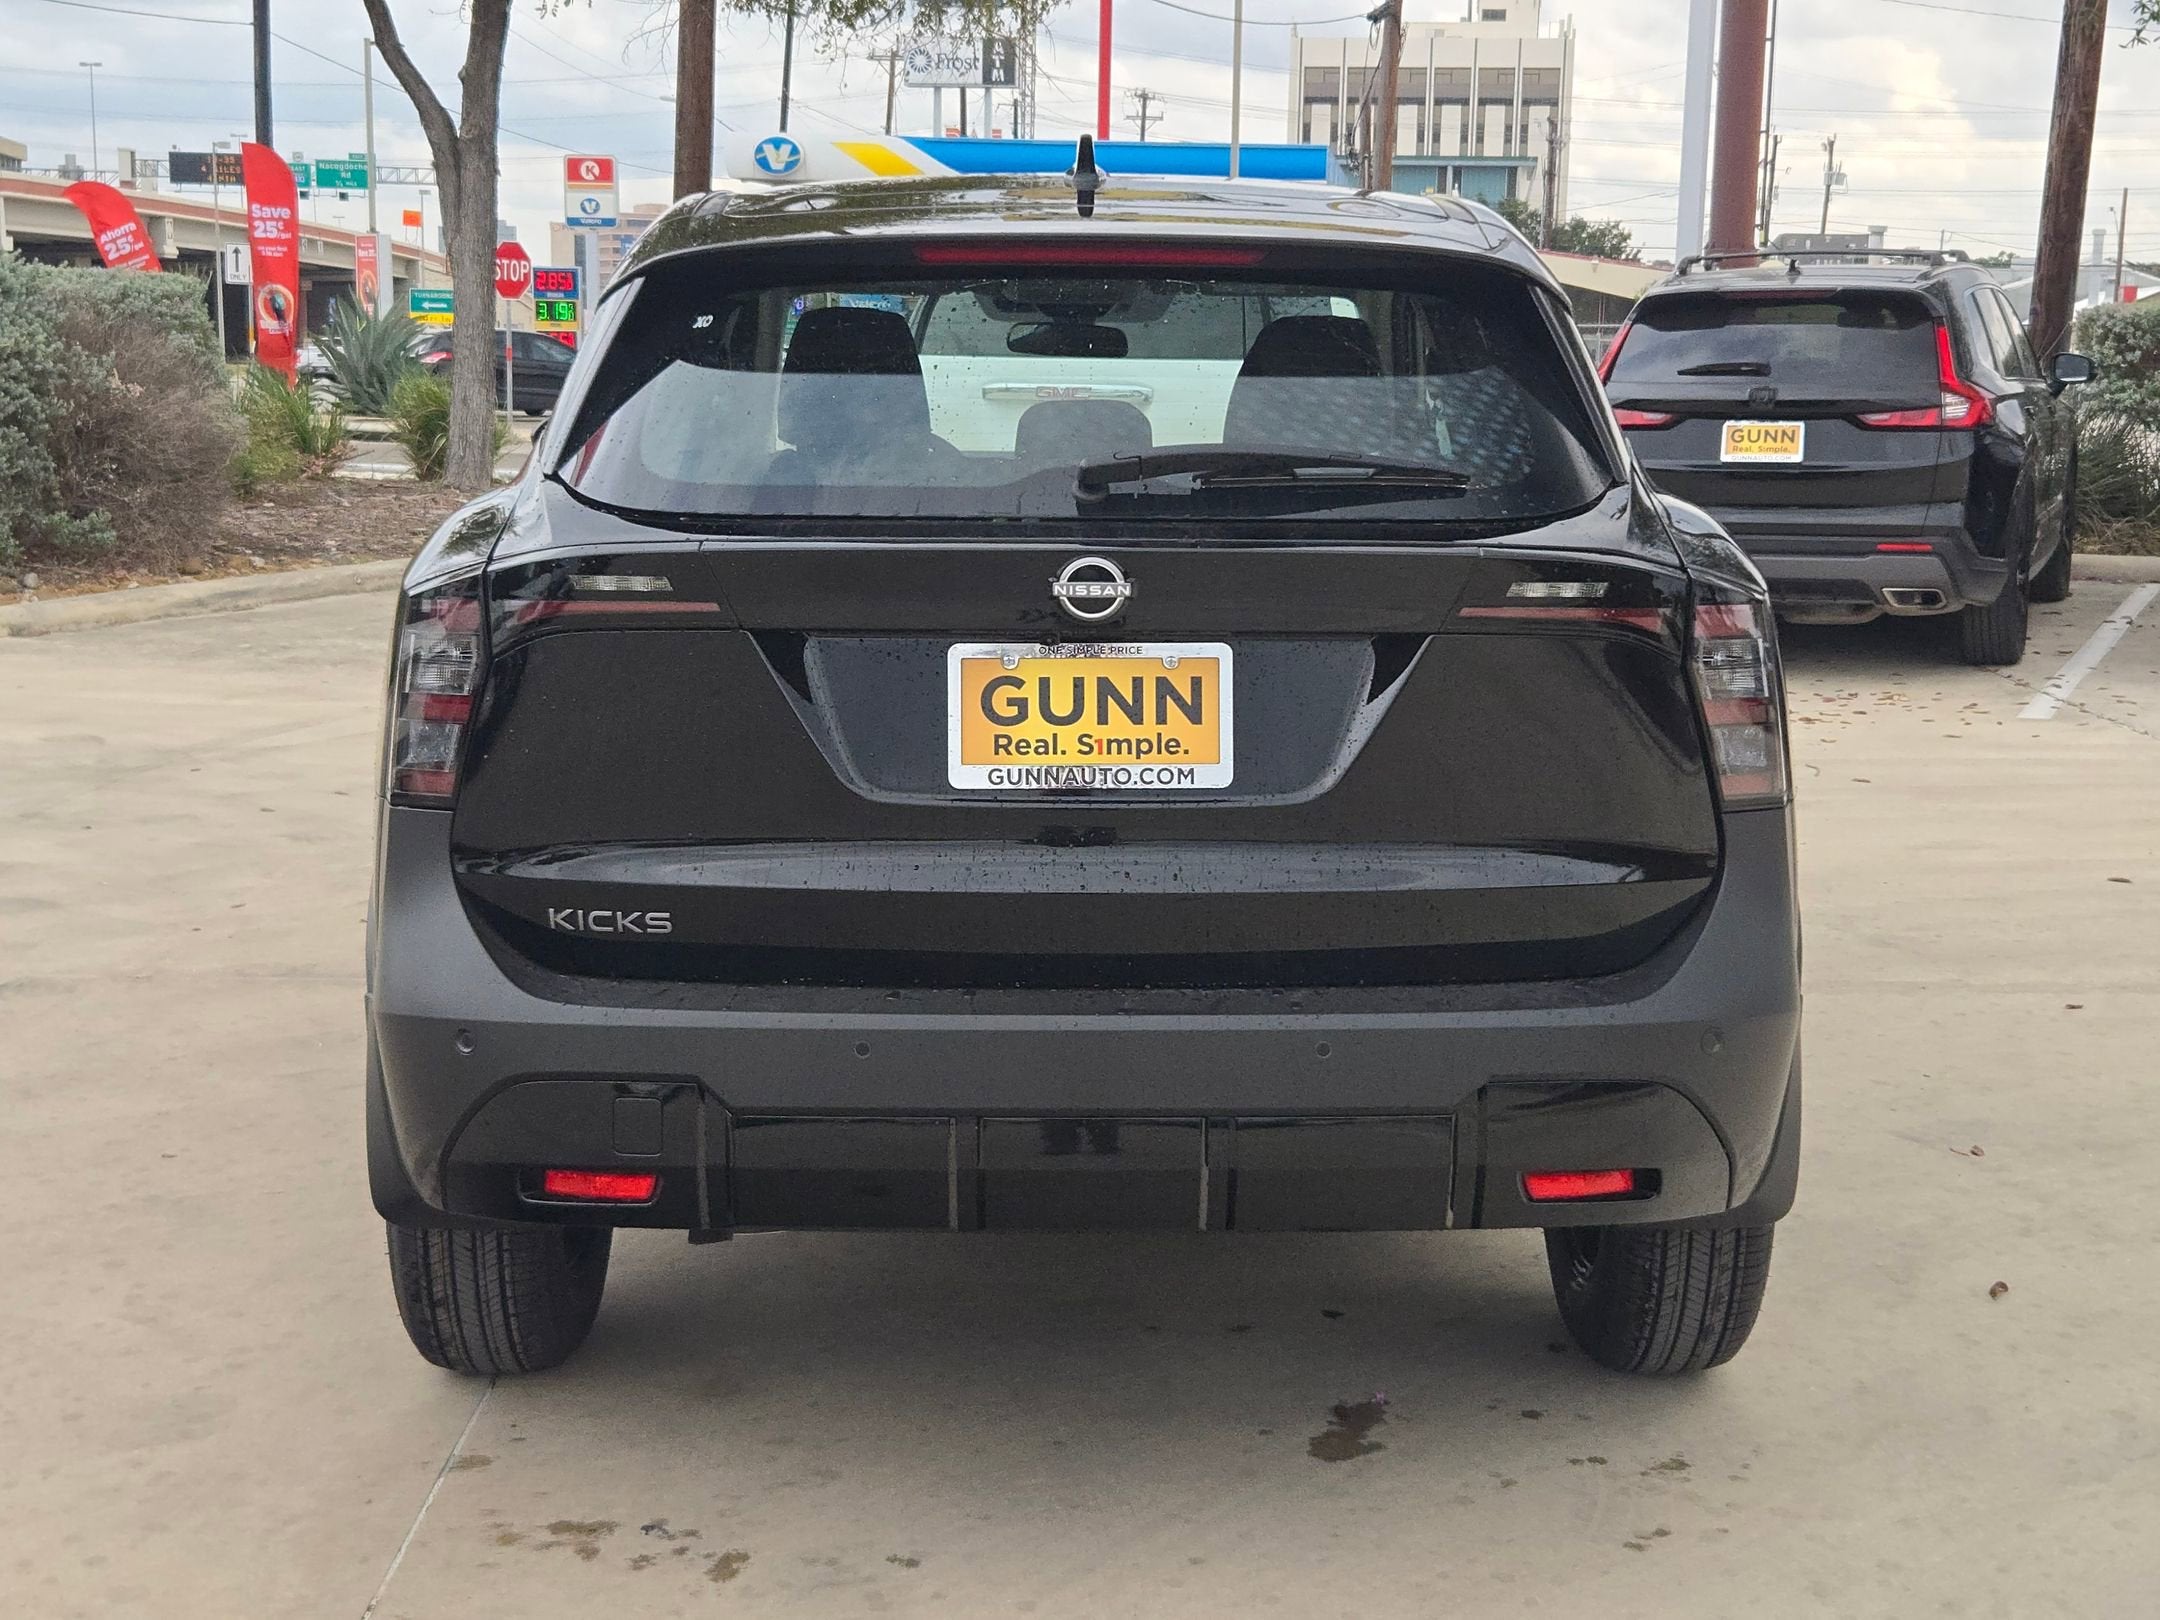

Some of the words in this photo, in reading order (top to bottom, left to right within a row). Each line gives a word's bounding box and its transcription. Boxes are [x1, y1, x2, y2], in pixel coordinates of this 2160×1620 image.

[935, 52, 980, 72] Frost
[991, 41, 1006, 82] ATM
[252, 203, 292, 219] Save
[100, 222, 137, 244] Ahorra
[495, 259, 530, 282] STOP
[1036, 386, 1091, 399] GMC
[1730, 428, 1796, 444] GUNN
[1732, 445, 1754, 453] Real.
[1054, 584, 1130, 596] NISSAN
[1039, 645, 1062, 655] ONE
[1066, 645, 1106, 655] SIMPLE
[1110, 645, 1143, 655] PRICE
[980, 675, 1203, 727] GUNN
[993, 733, 1067, 756] Real.
[988, 767, 1196, 787] GUNNAUTO.COM
[548, 907, 673, 934] KICKS
